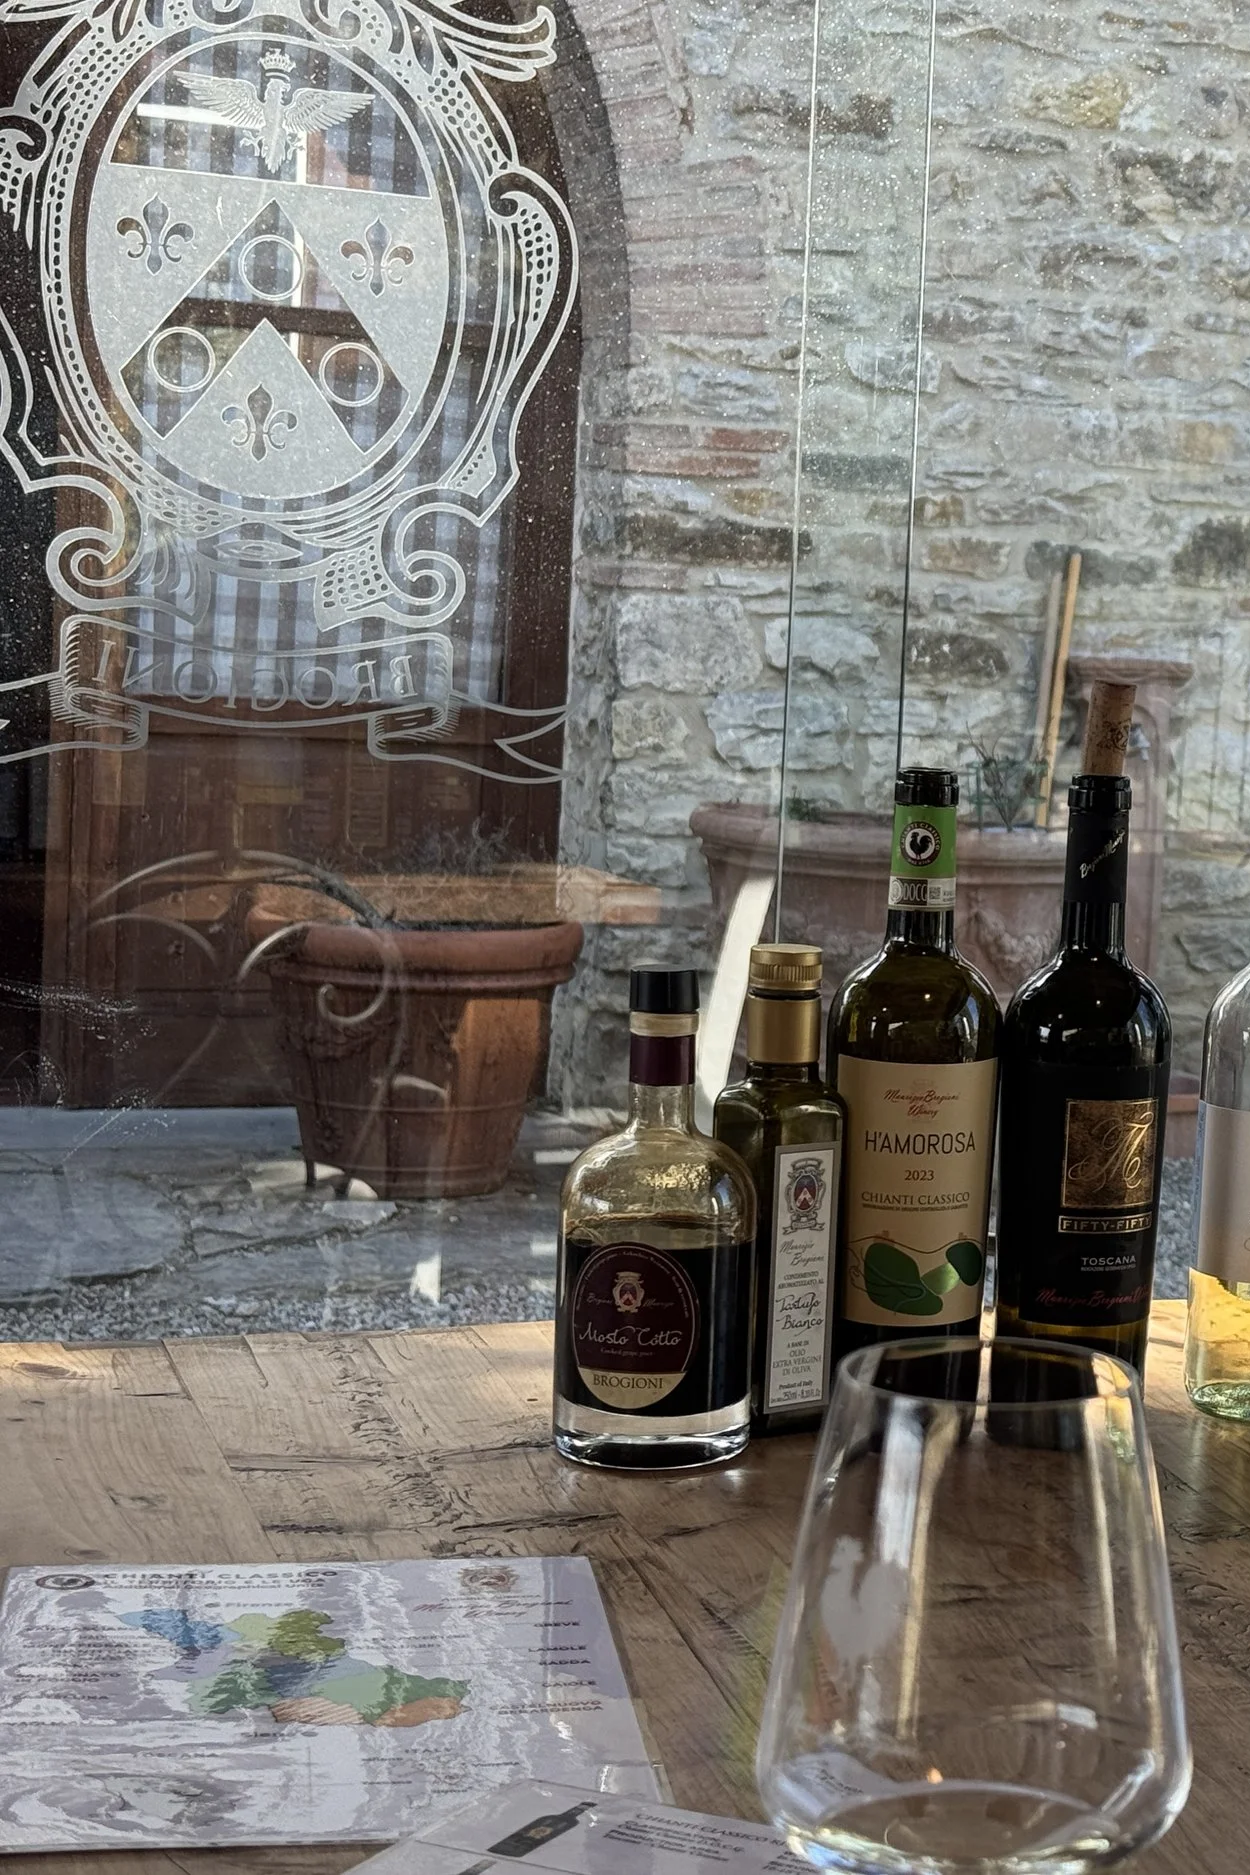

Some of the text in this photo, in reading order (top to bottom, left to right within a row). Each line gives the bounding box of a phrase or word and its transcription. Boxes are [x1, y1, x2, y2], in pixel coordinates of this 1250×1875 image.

[907, 1104, 939, 1118] Winery
[864, 1129, 976, 1155] H'AMOROSA
[904, 1169, 935, 1181] 2023
[861, 1191, 970, 1205] CHIANTI CLASSICO
[1062, 1217, 1150, 1231] FIFTY-FIFTY
[1081, 1255, 1136, 1266] TOSCANA
[776, 1292, 821, 1315] Tartufo
[776, 1314, 824, 1336] Bianco
[579, 1321, 683, 1346] Mosto Cotto
[789, 1349, 806, 1358] OLIO
[773, 1355, 822, 1369] EXTRA VERGINE
[782, 1365, 812, 1376] DI OLIVA
[593, 1374, 663, 1390] BROGIONI
[217, 1570, 338, 1579] CLASSICO
[489, 1700, 602, 1710] CASTELNUOVO
[498, 1706, 604, 1715] BERARDENGA
[635, 1813, 767, 1842] CHIANTI CLASSICO
